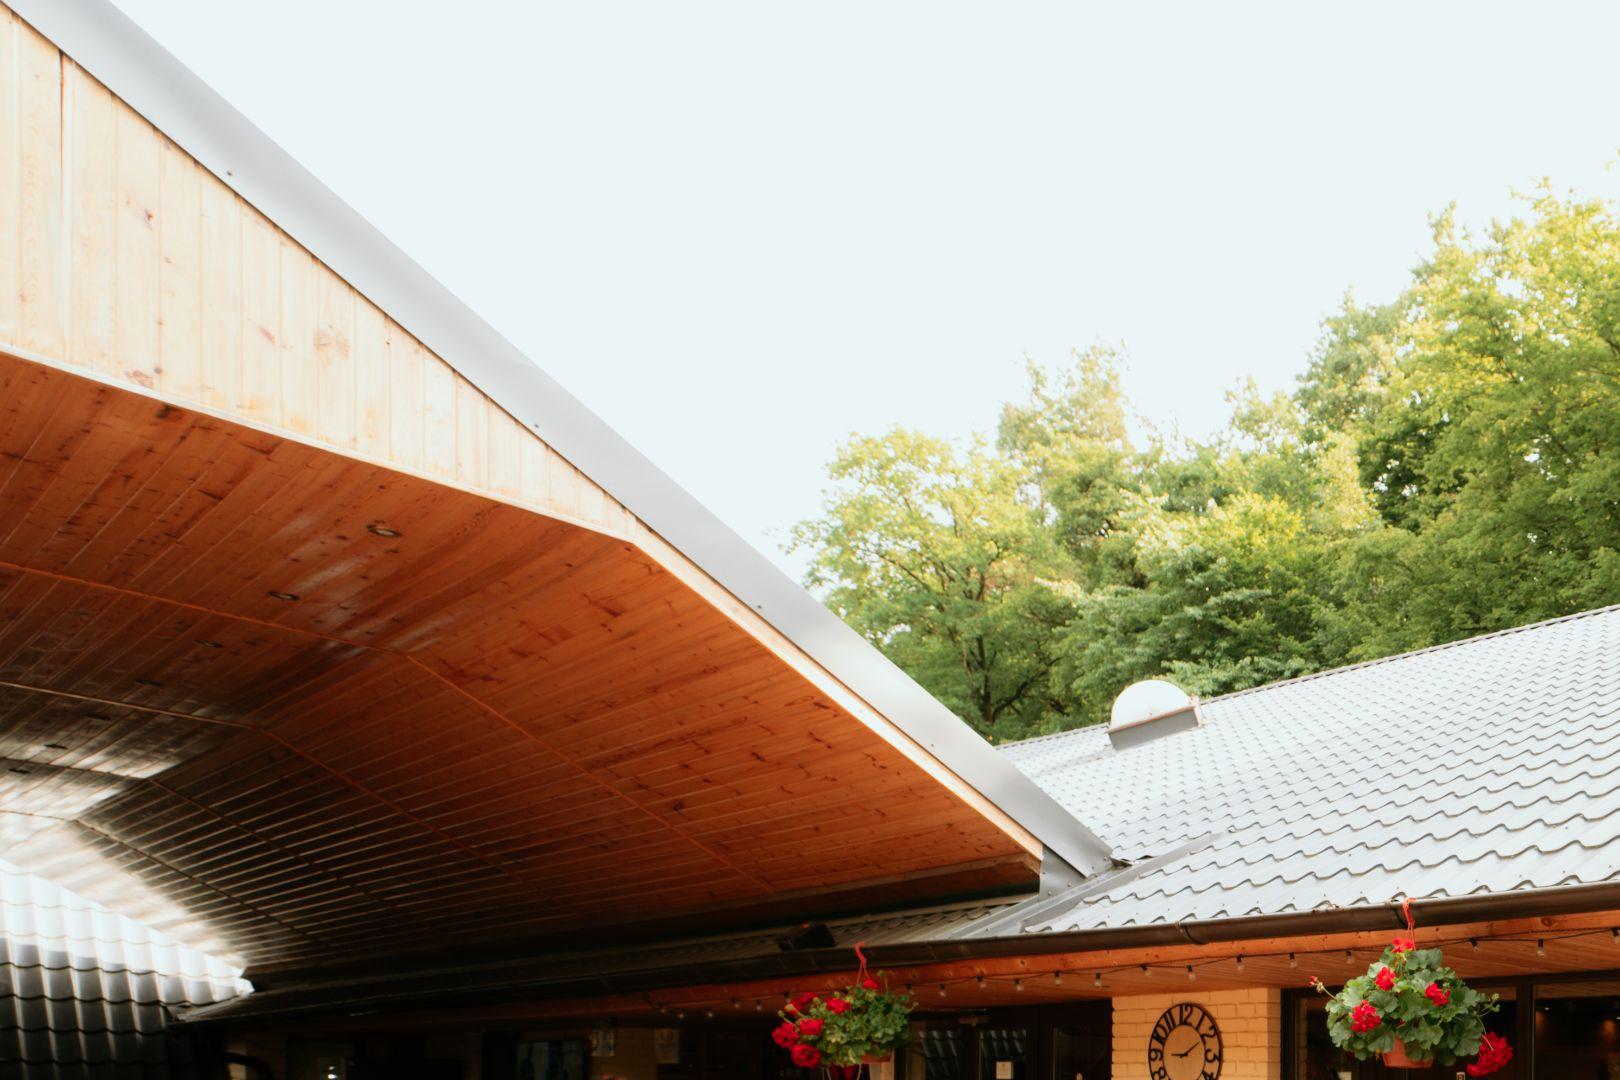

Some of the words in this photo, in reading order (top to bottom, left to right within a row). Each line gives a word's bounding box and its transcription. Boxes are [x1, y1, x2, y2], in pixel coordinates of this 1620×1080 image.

[1179, 1004, 1194, 1026] 12
[1201, 1024, 1217, 1038] 2
[1149, 1048, 1164, 1062] 9
[1205, 1048, 1221, 1063] 3
